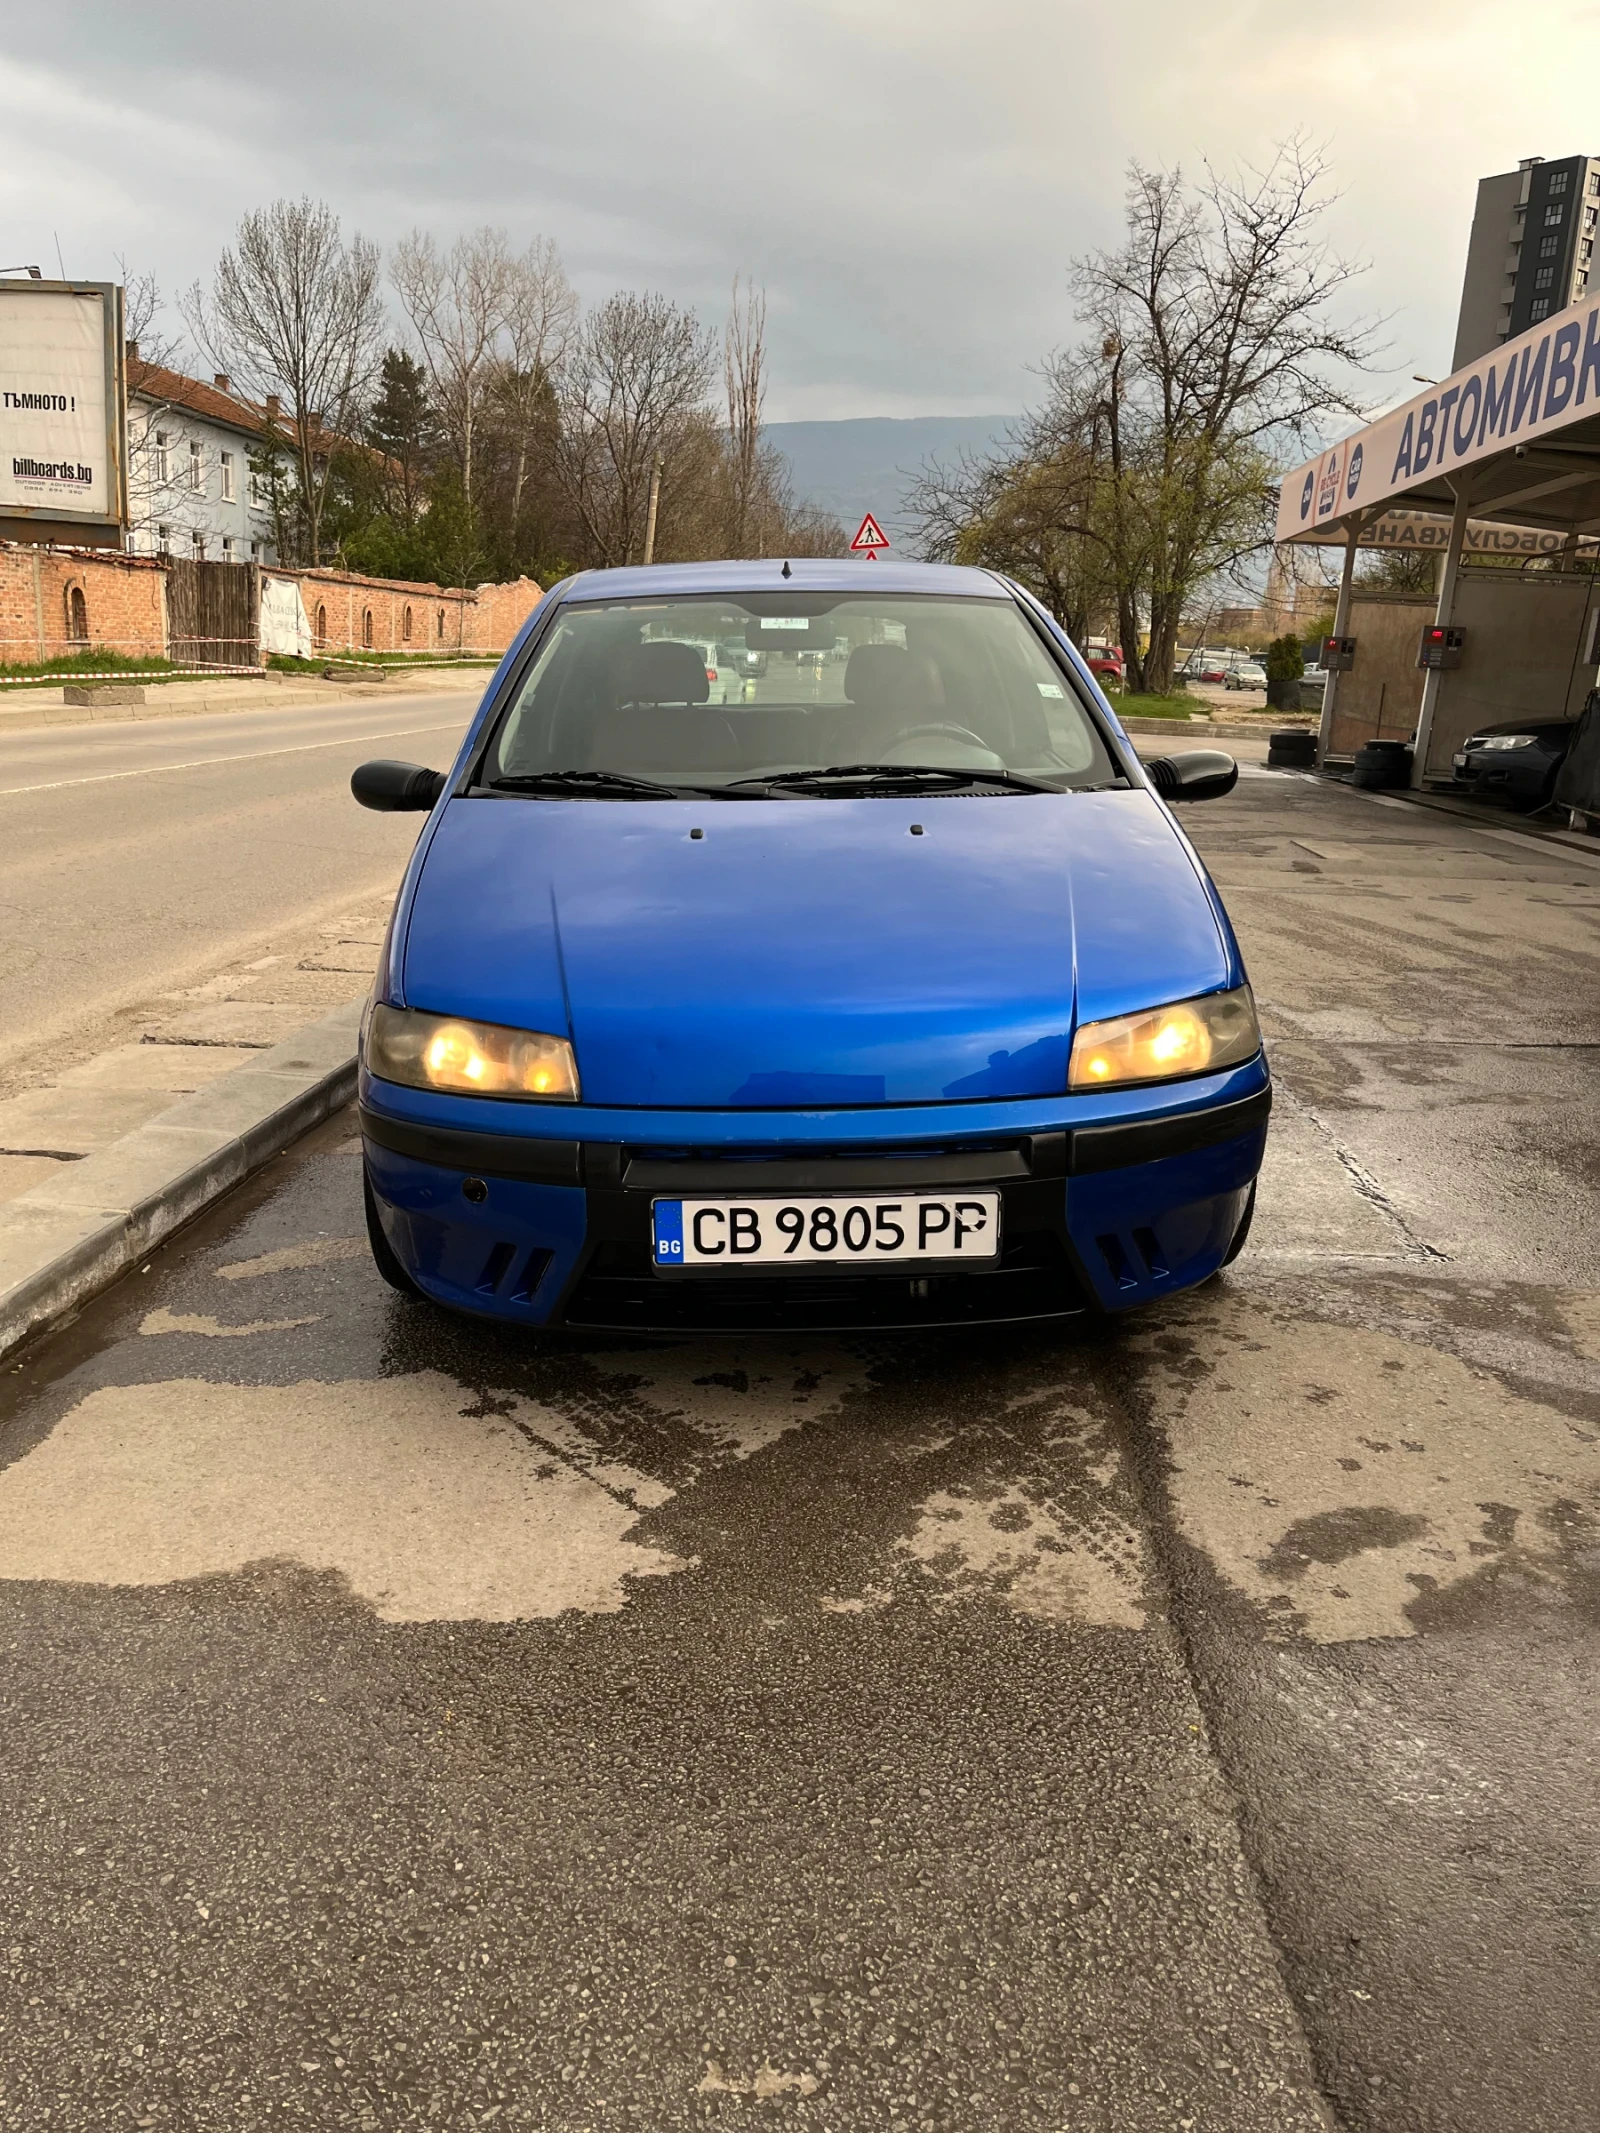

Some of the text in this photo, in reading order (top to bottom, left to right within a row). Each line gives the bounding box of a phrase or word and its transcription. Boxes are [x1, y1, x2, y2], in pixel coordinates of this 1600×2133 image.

[3, 392, 67, 412] ТЪМНОТО
[13, 457, 92, 484] billboards.bg
[50, 481, 91, 491] ADVERTISING
[693, 1208, 762, 1254] CB
[775, 1205, 905, 1253] 9805
[659, 1240, 681, 1254] BG
